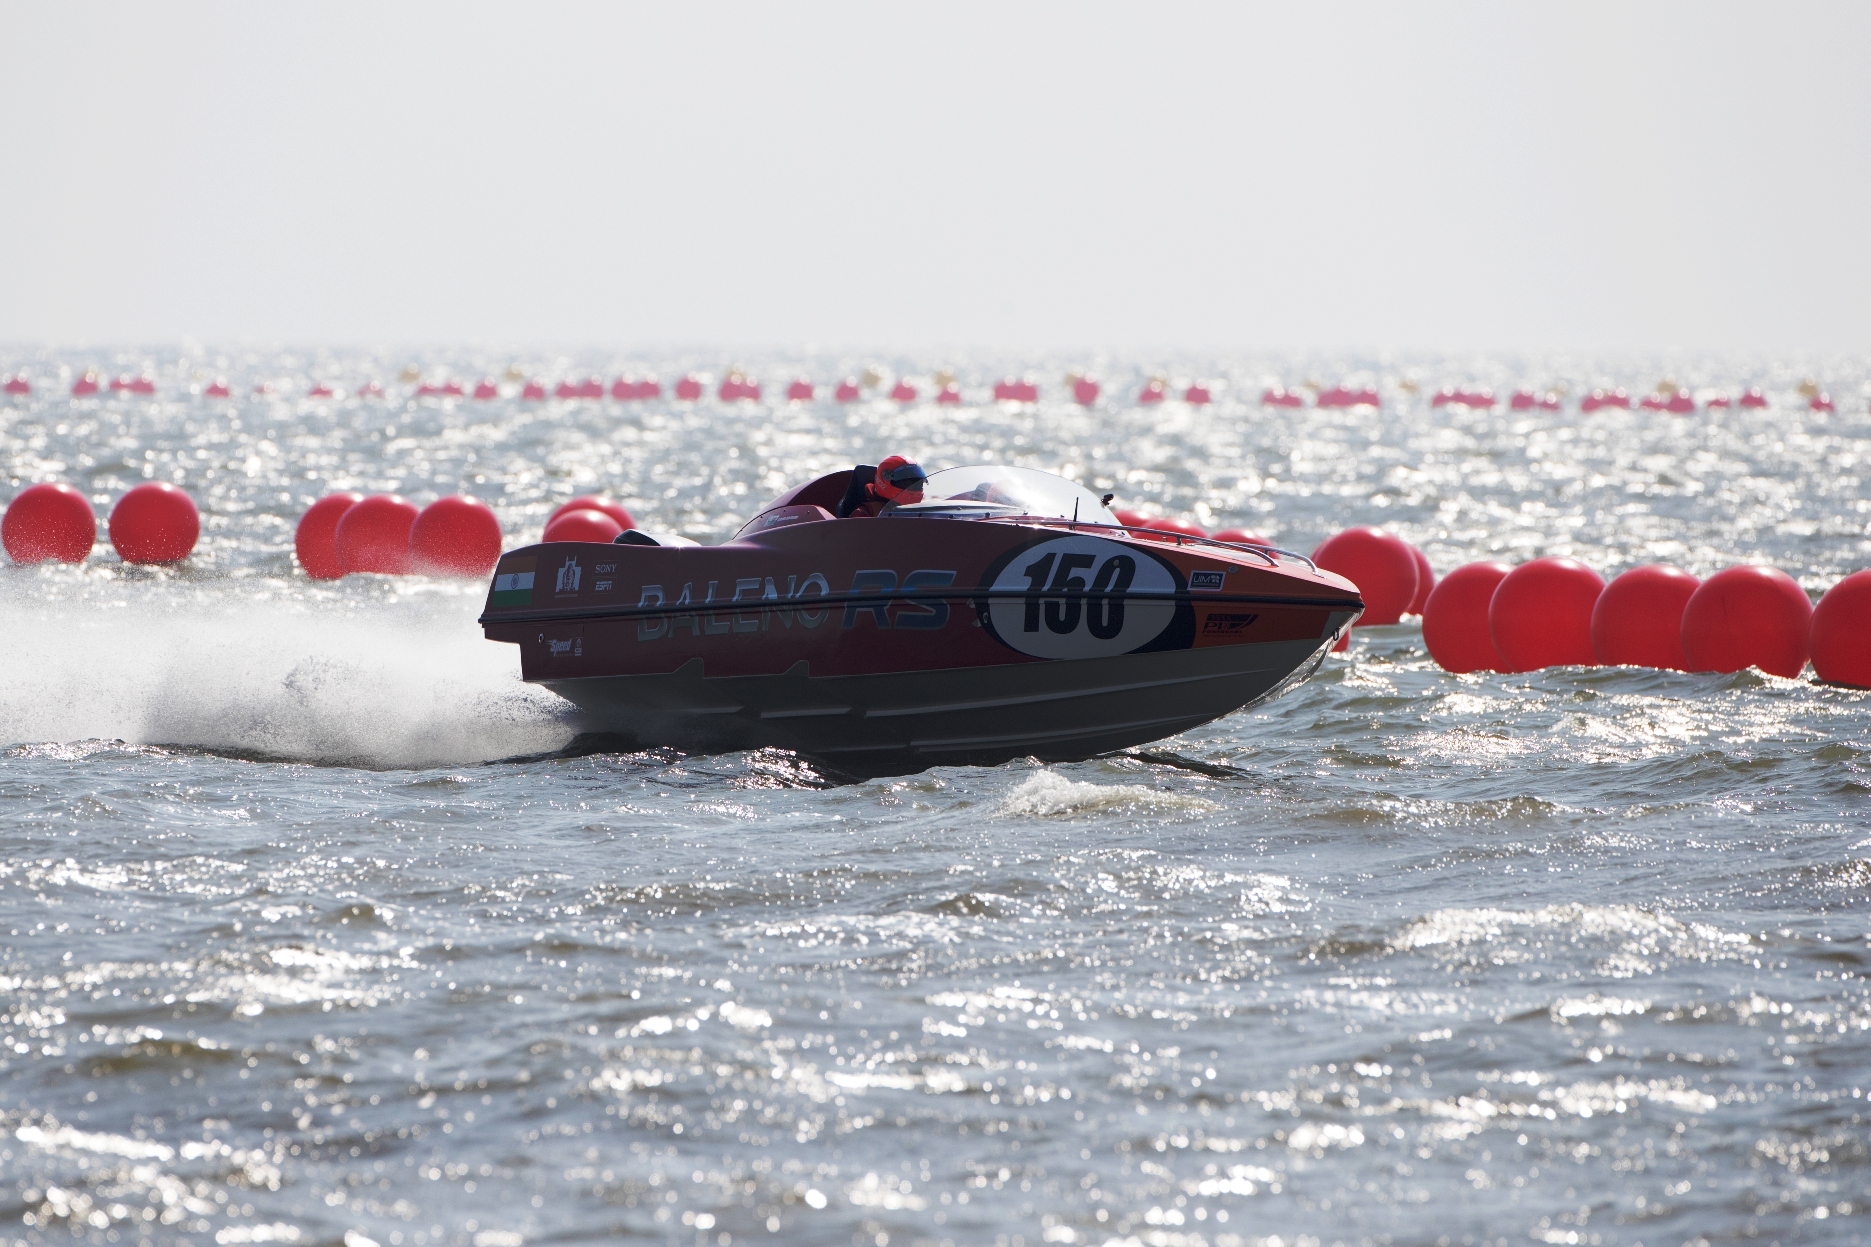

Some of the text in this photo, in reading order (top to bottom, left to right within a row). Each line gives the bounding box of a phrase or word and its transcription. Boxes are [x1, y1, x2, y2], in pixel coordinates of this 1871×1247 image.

[595, 564, 617, 573] SONY
[595, 581, 613, 591] ESPN
[637, 569, 957, 641] BALENO RS
[1022, 552, 1136, 640] 150
[549, 638, 572, 657] Speed
